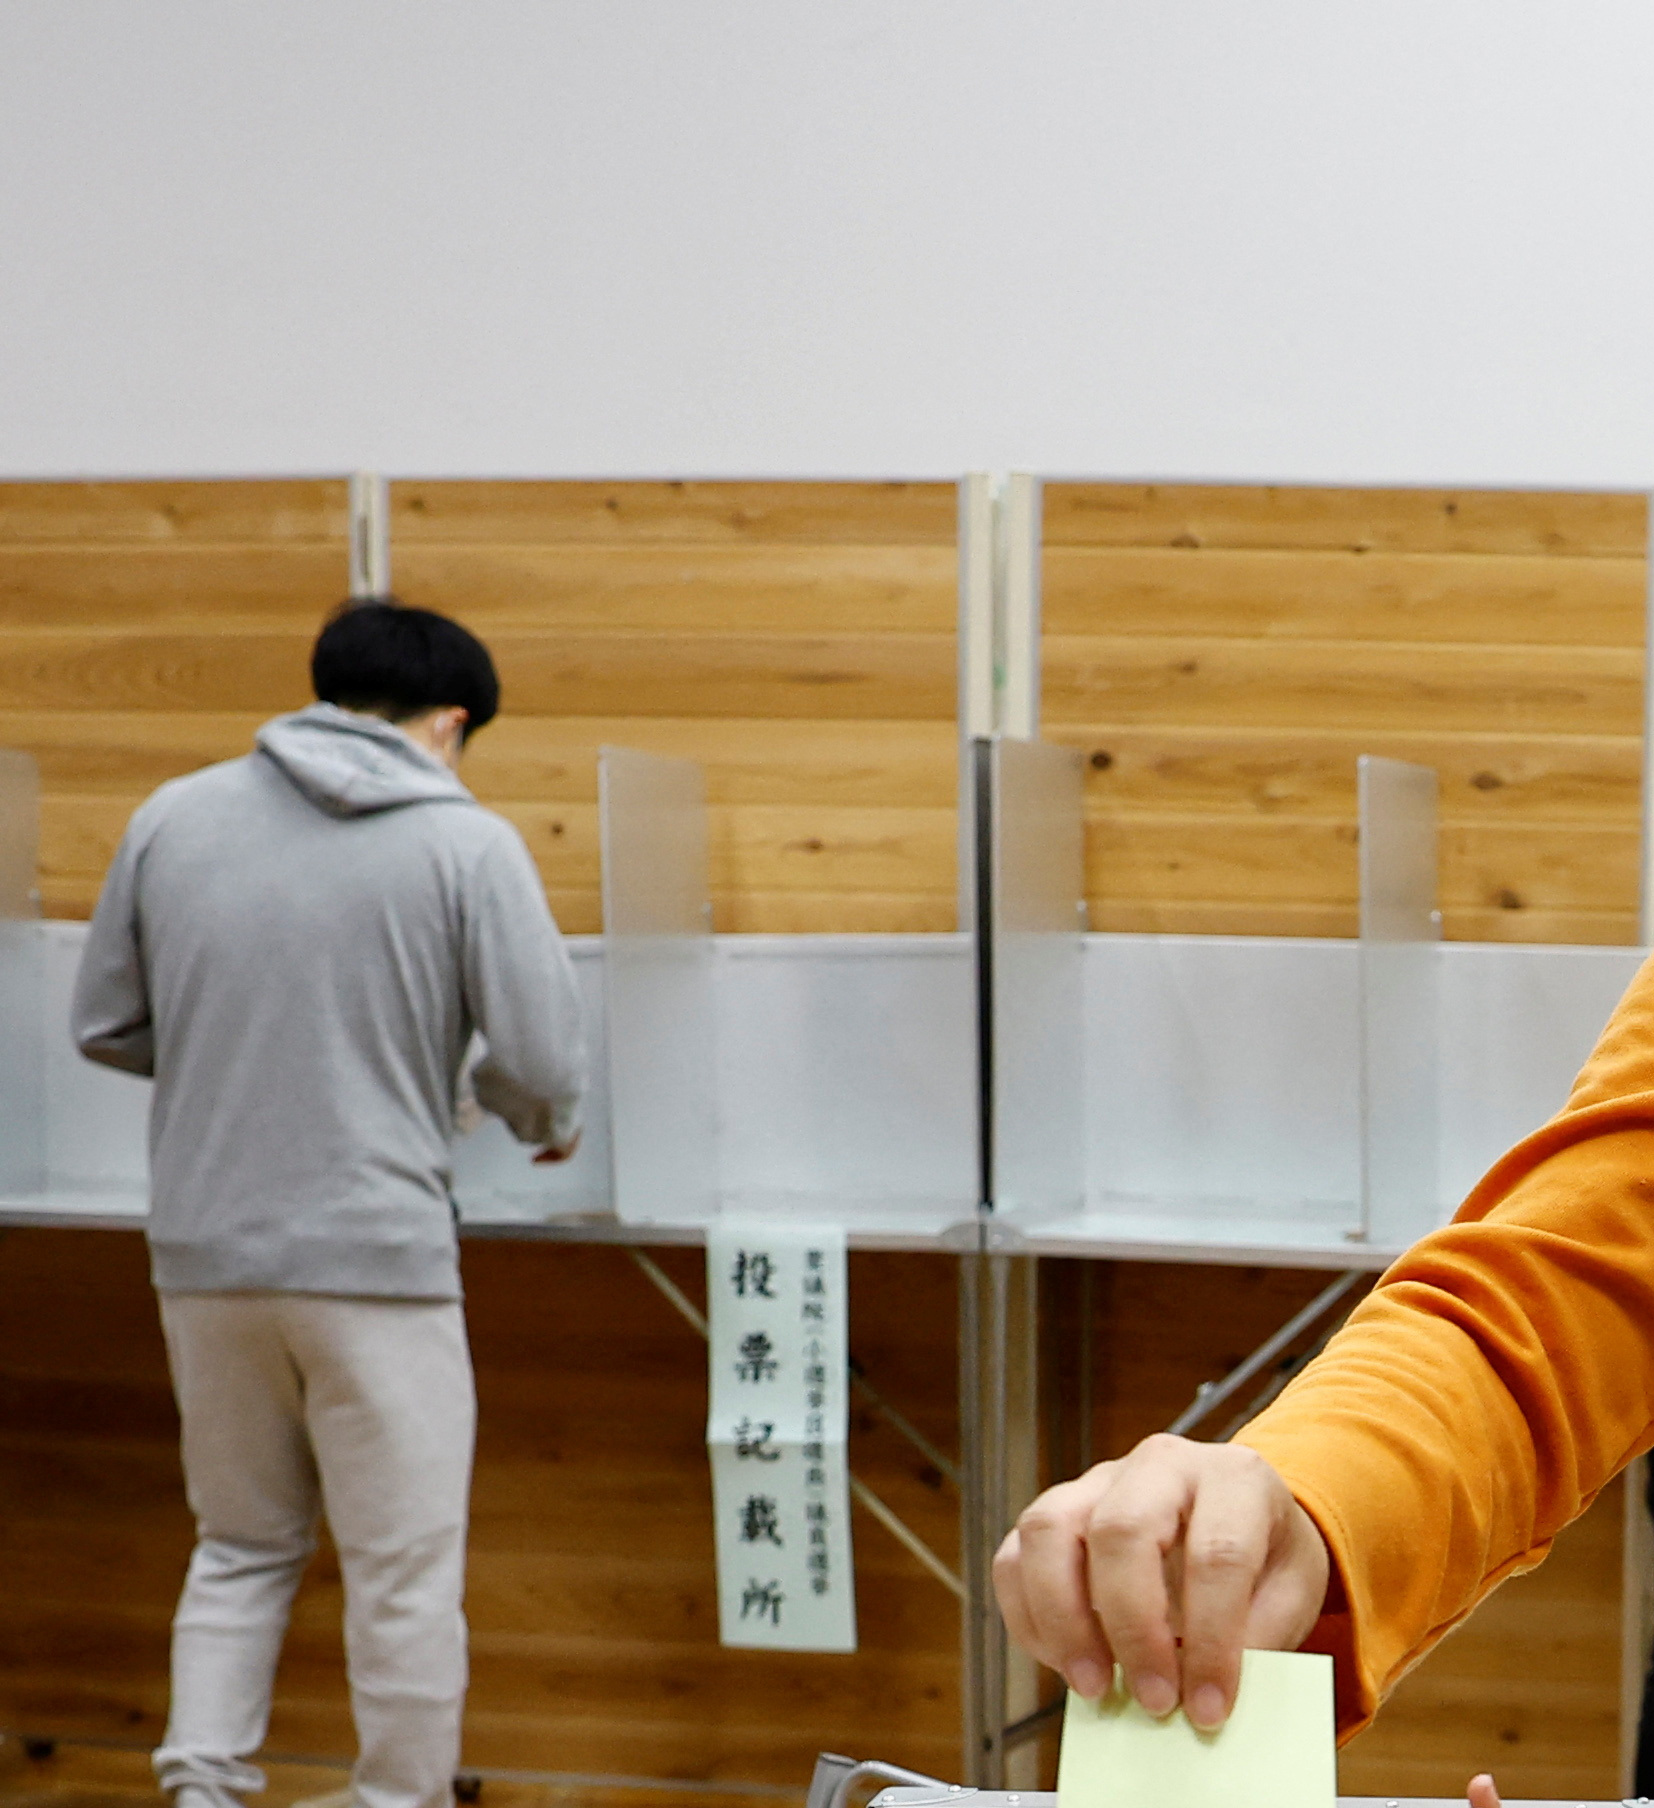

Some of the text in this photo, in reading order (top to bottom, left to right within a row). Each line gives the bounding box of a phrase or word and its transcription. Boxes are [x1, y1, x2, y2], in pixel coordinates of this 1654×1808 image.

[731, 1249, 786, 1627] 投票記載所
